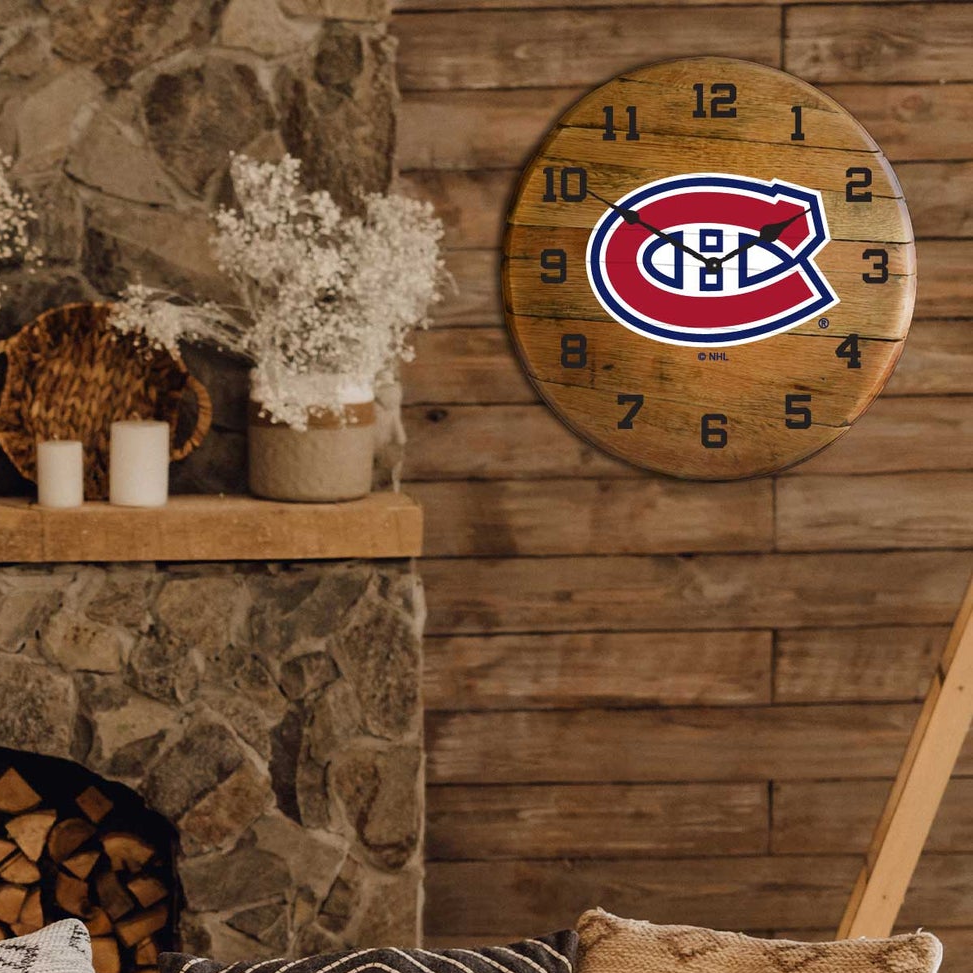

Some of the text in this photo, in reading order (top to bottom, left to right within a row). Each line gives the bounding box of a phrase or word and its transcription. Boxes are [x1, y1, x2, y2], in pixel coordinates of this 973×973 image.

[693, 84, 737, 118] 12
[602, 106, 640, 141] 11
[790, 106, 805, 141] 1
[543, 167, 587, 202] 10
[845, 167, 873, 202] 2
[540, 249, 567, 284] 9
[862, 249, 889, 284] 3
[560, 334, 588, 369] 8
[709, 352, 729, 361] NHL
[835, 334, 861, 369] 4
[617, 395, 644, 429] 7
[785, 395, 812, 429] 5
[701, 414, 728, 448] 6
